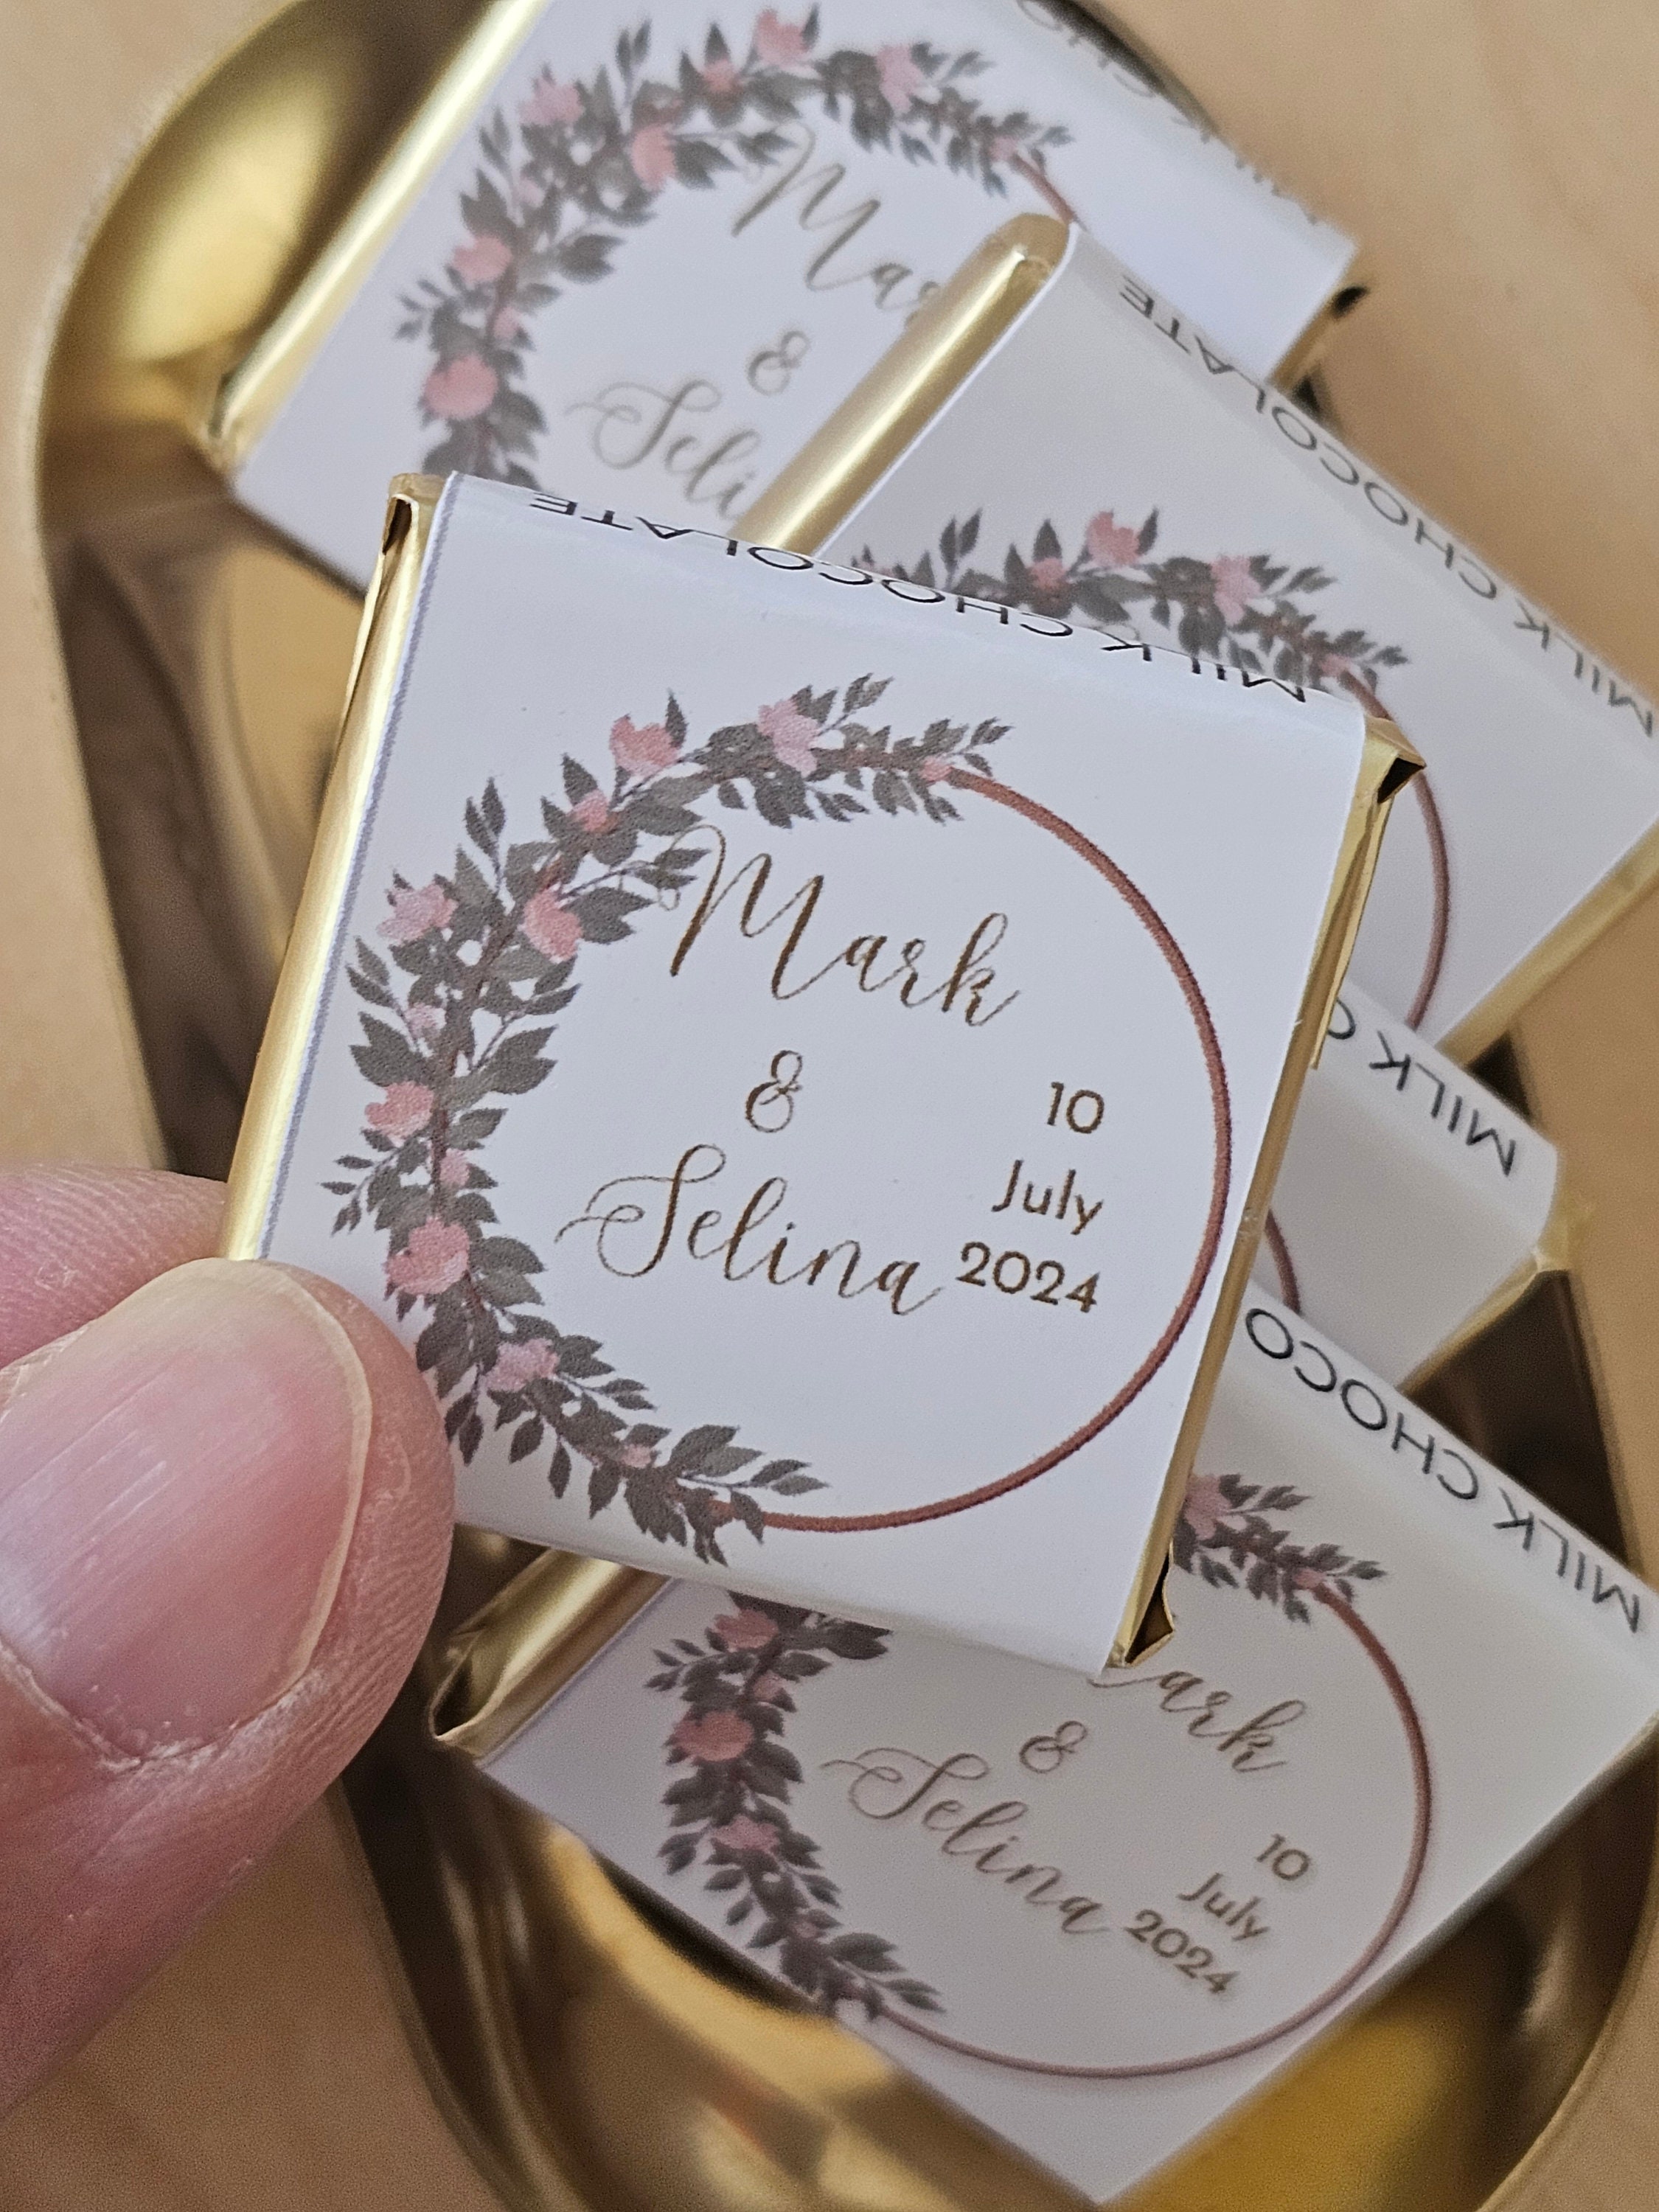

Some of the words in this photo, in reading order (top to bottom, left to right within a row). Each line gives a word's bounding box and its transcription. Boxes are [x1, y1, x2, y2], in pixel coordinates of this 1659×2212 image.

[731, 122, 941, 330] Ma
[746, 329, 811, 397] &
[565, 379, 760, 520] Seli
[1119, 276, 1498, 601] CHOCOLATE
[1513, 597, 1653, 738] MILK
[656, 824, 1020, 1027] Mark
[746, 1050, 802, 1133] &
[1048, 1082, 1105, 1134] 10
[1368, 1030, 1516, 1177] MILK
[554, 1144, 945, 1315] Selina
[992, 1159, 1103, 1236] July
[956, 1241, 1101, 1314] 2024
[1245, 1308, 1479, 1500] CHOCO
[1492, 1487, 1640, 1634] MILK
[1020, 1720, 1088, 1773] &
[1087, 1670, 1307, 1773] ark
[820, 1747, 1110, 1935] Selina
[1256, 1833, 1311, 1882] 10
[1124, 1909, 1240, 1994] 2024
[1178, 1873, 1270, 1942] July
